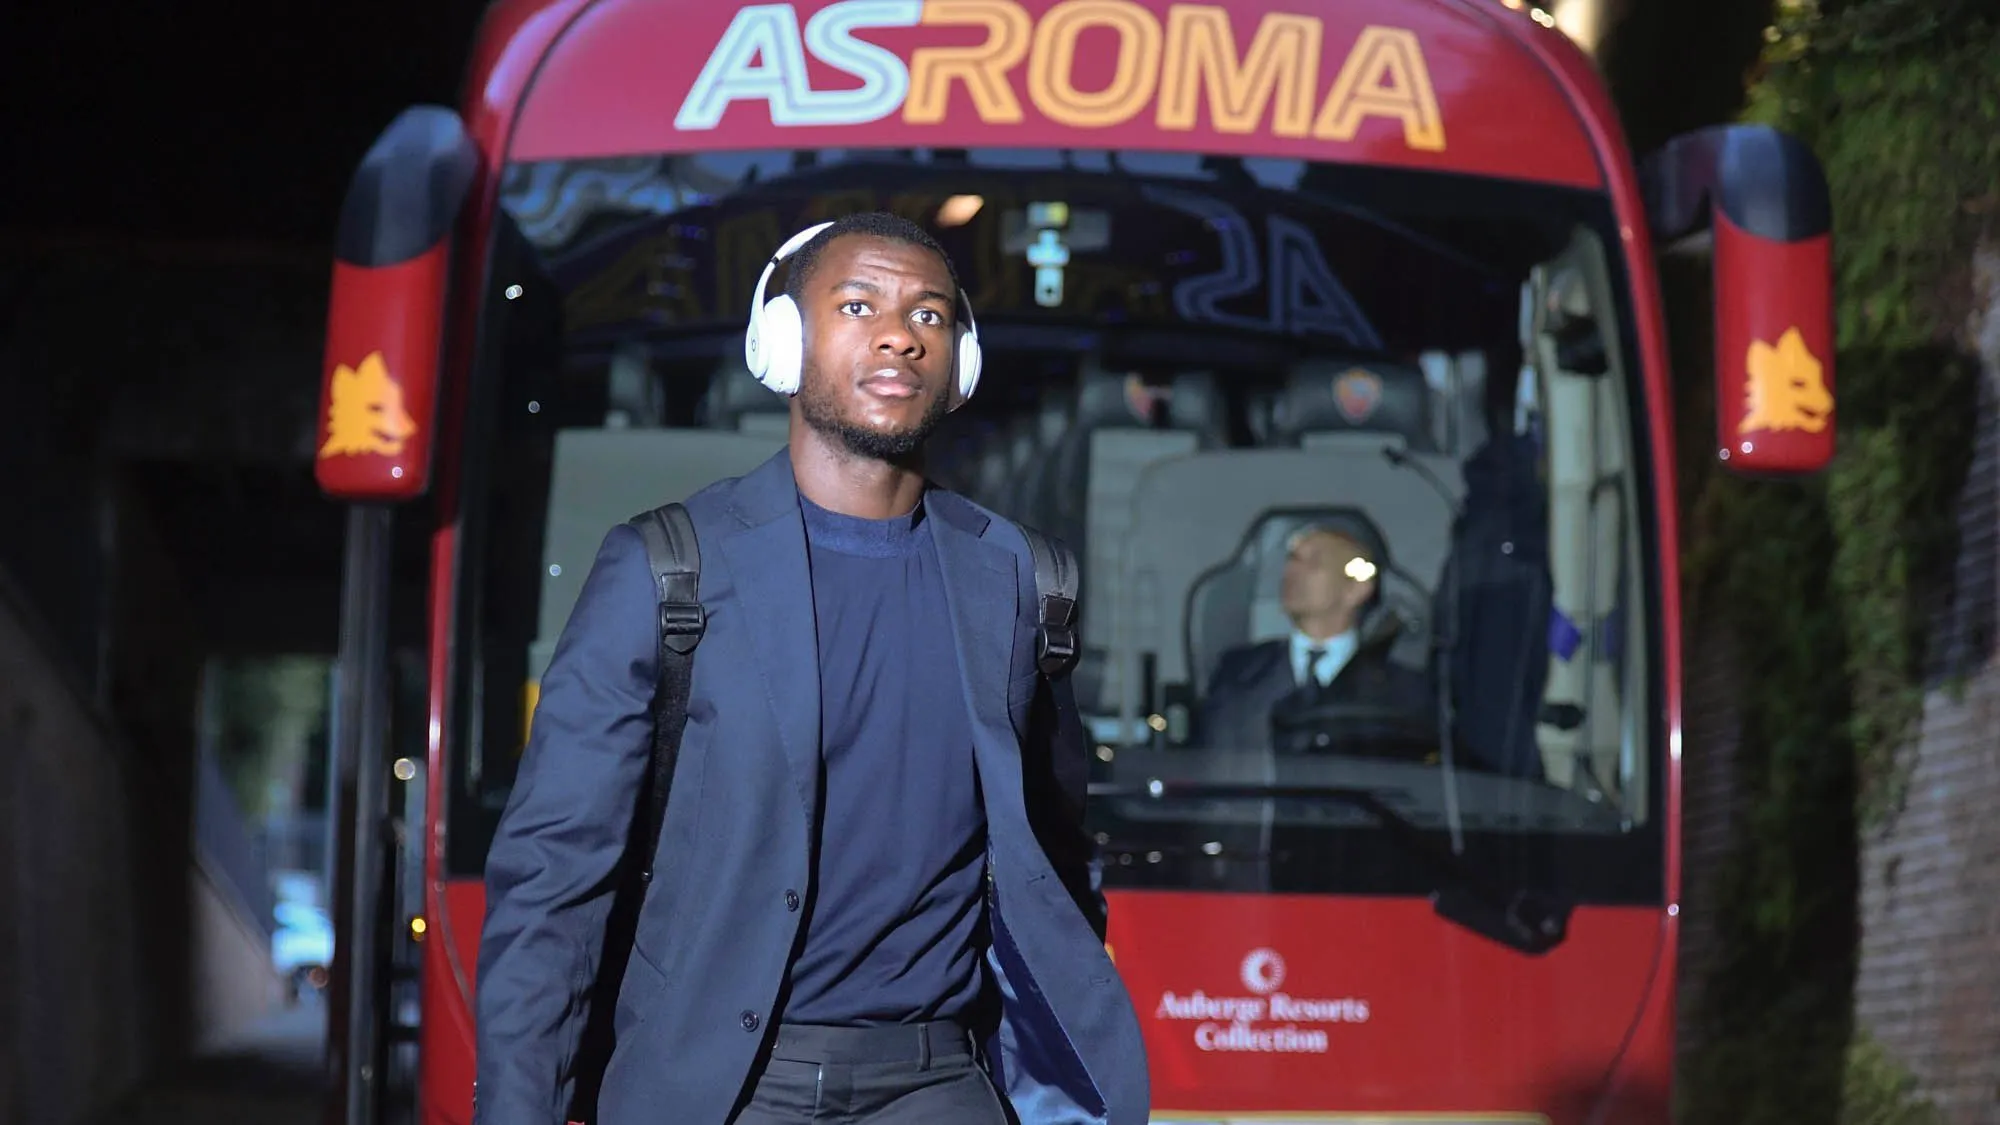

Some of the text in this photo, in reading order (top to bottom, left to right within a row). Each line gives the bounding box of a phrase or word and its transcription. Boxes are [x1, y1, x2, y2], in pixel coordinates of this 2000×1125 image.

[1156, 990, 1370, 1023] Auberge Resorts
[1194, 1021, 1329, 1052] Collection
